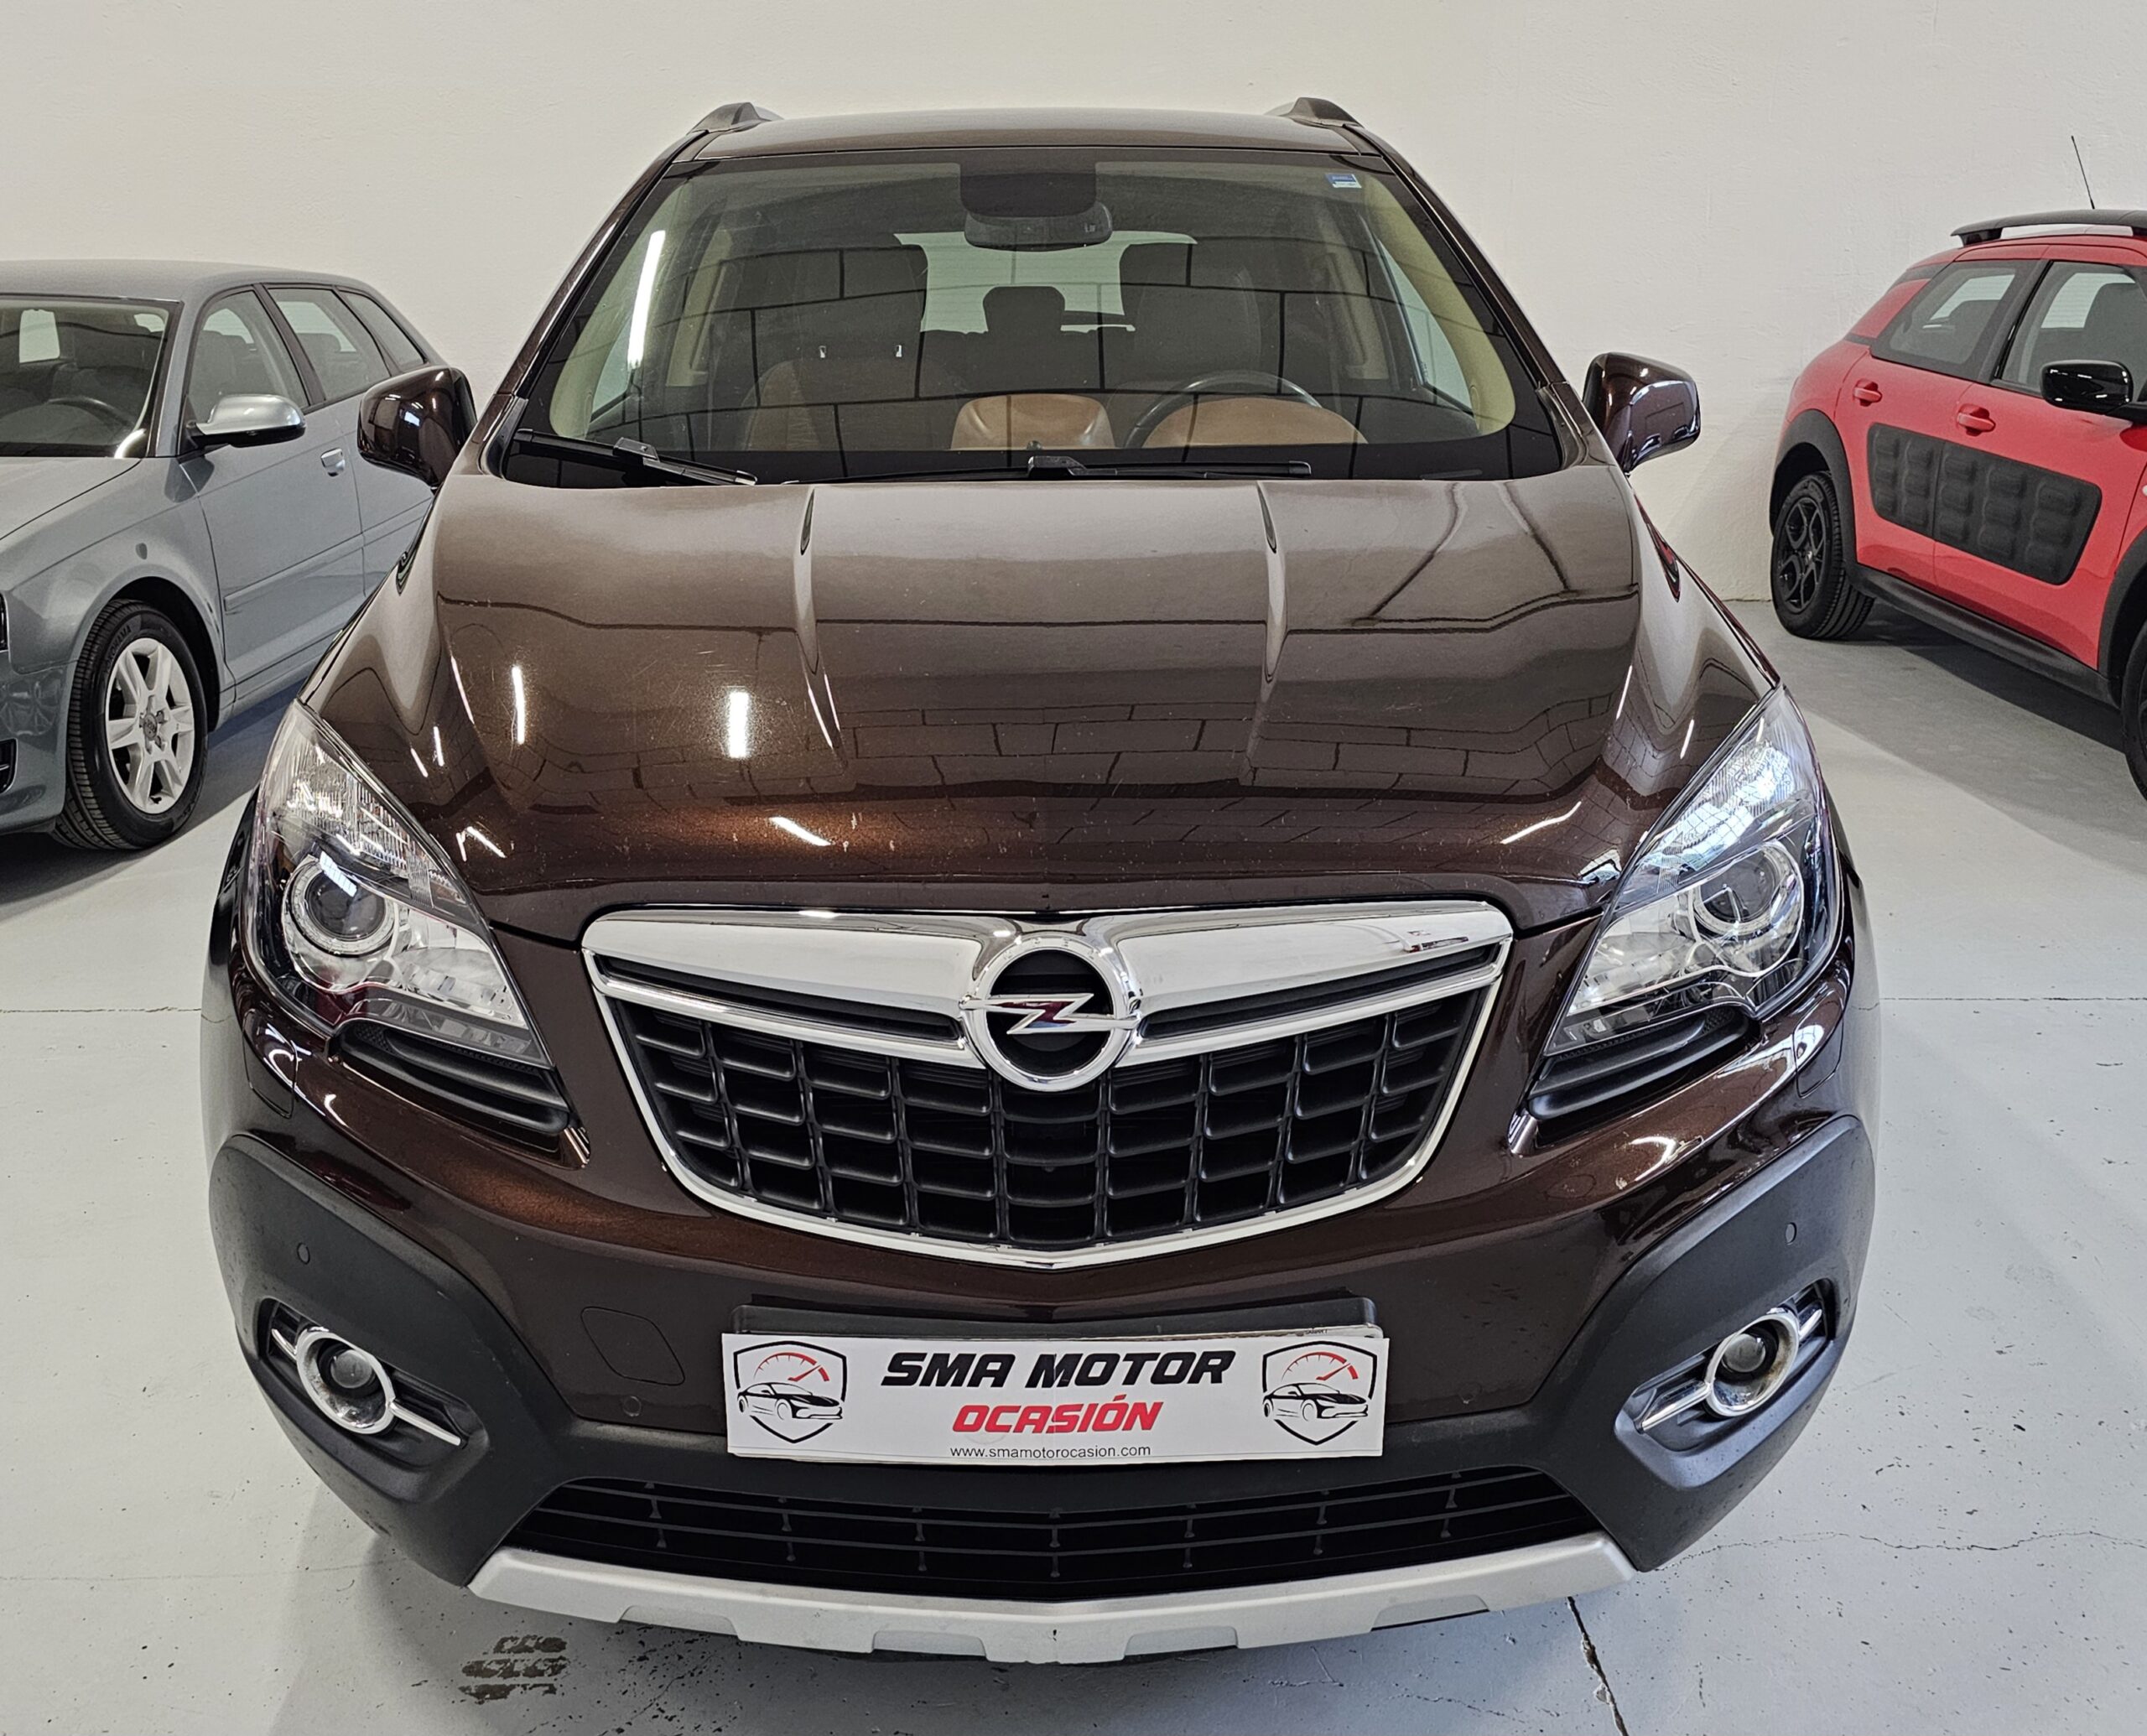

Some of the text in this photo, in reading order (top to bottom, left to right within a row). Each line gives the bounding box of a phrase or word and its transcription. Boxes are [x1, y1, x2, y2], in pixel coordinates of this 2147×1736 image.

[881, 1350, 1236, 1389] SMA MOTOR
[952, 1394, 1164, 1434] OCASIÓN
[949, 1445, 1151, 1459] www.smamotorocasion.com
